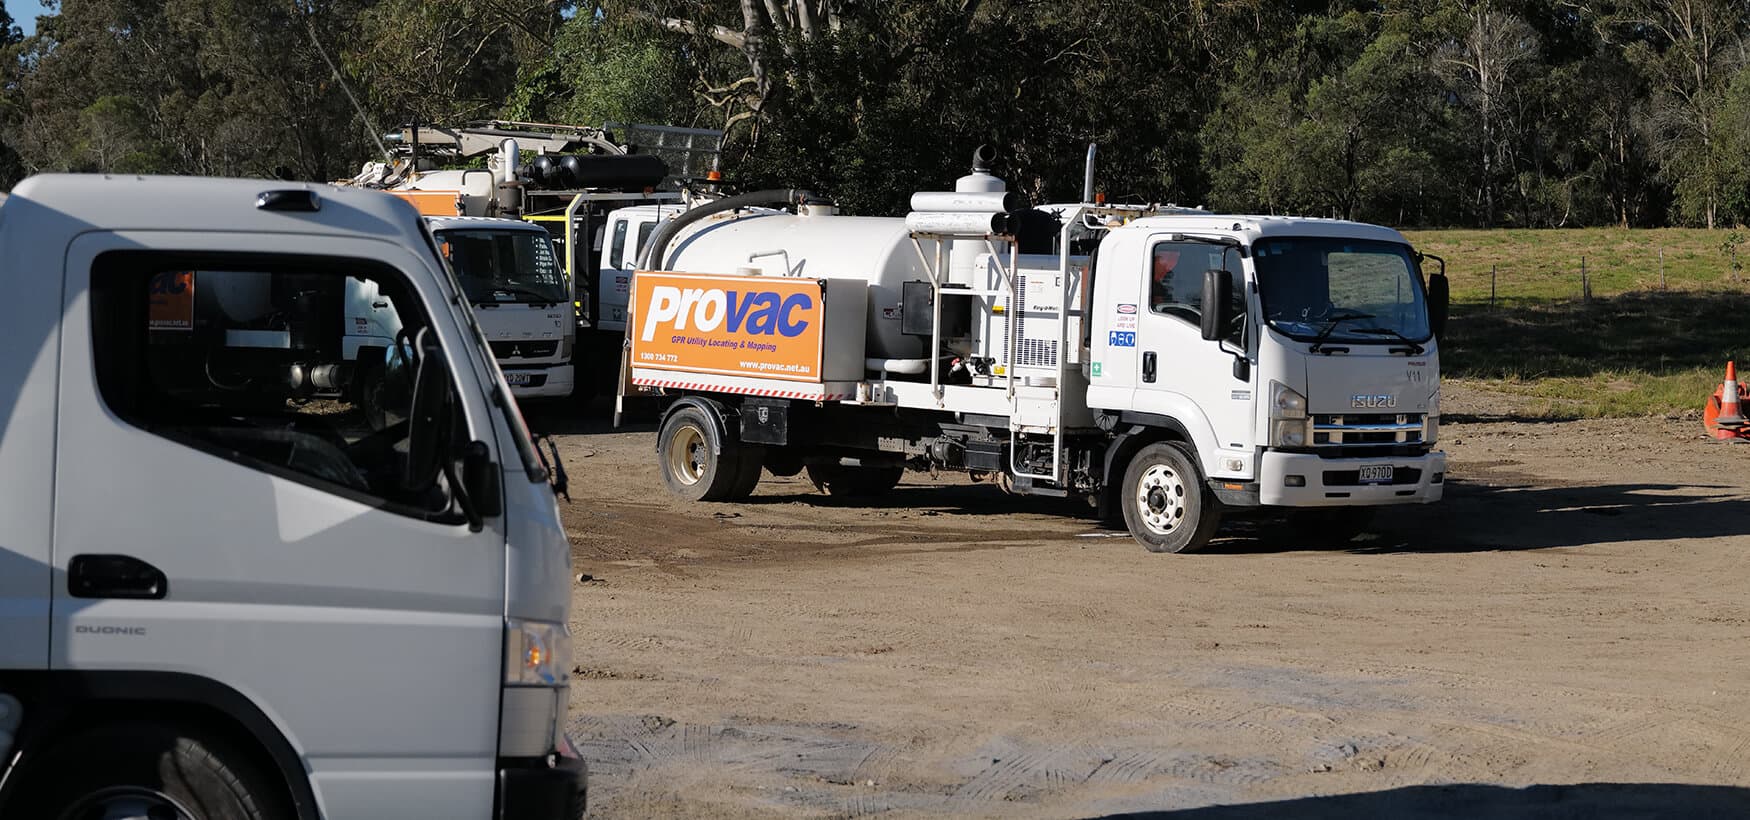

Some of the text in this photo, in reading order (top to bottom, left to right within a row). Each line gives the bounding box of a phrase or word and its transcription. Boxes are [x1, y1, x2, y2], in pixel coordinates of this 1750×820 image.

[641, 285, 812, 342] provac
[671, 335, 777, 352] GPR Utility Locating & Mapping
[640, 352, 678, 363] 1300 734 772
[739, 359, 810, 373] www.provac.net.au
[1351, 394, 1397, 408] ISUZU
[75, 625, 146, 636] DUONIC
